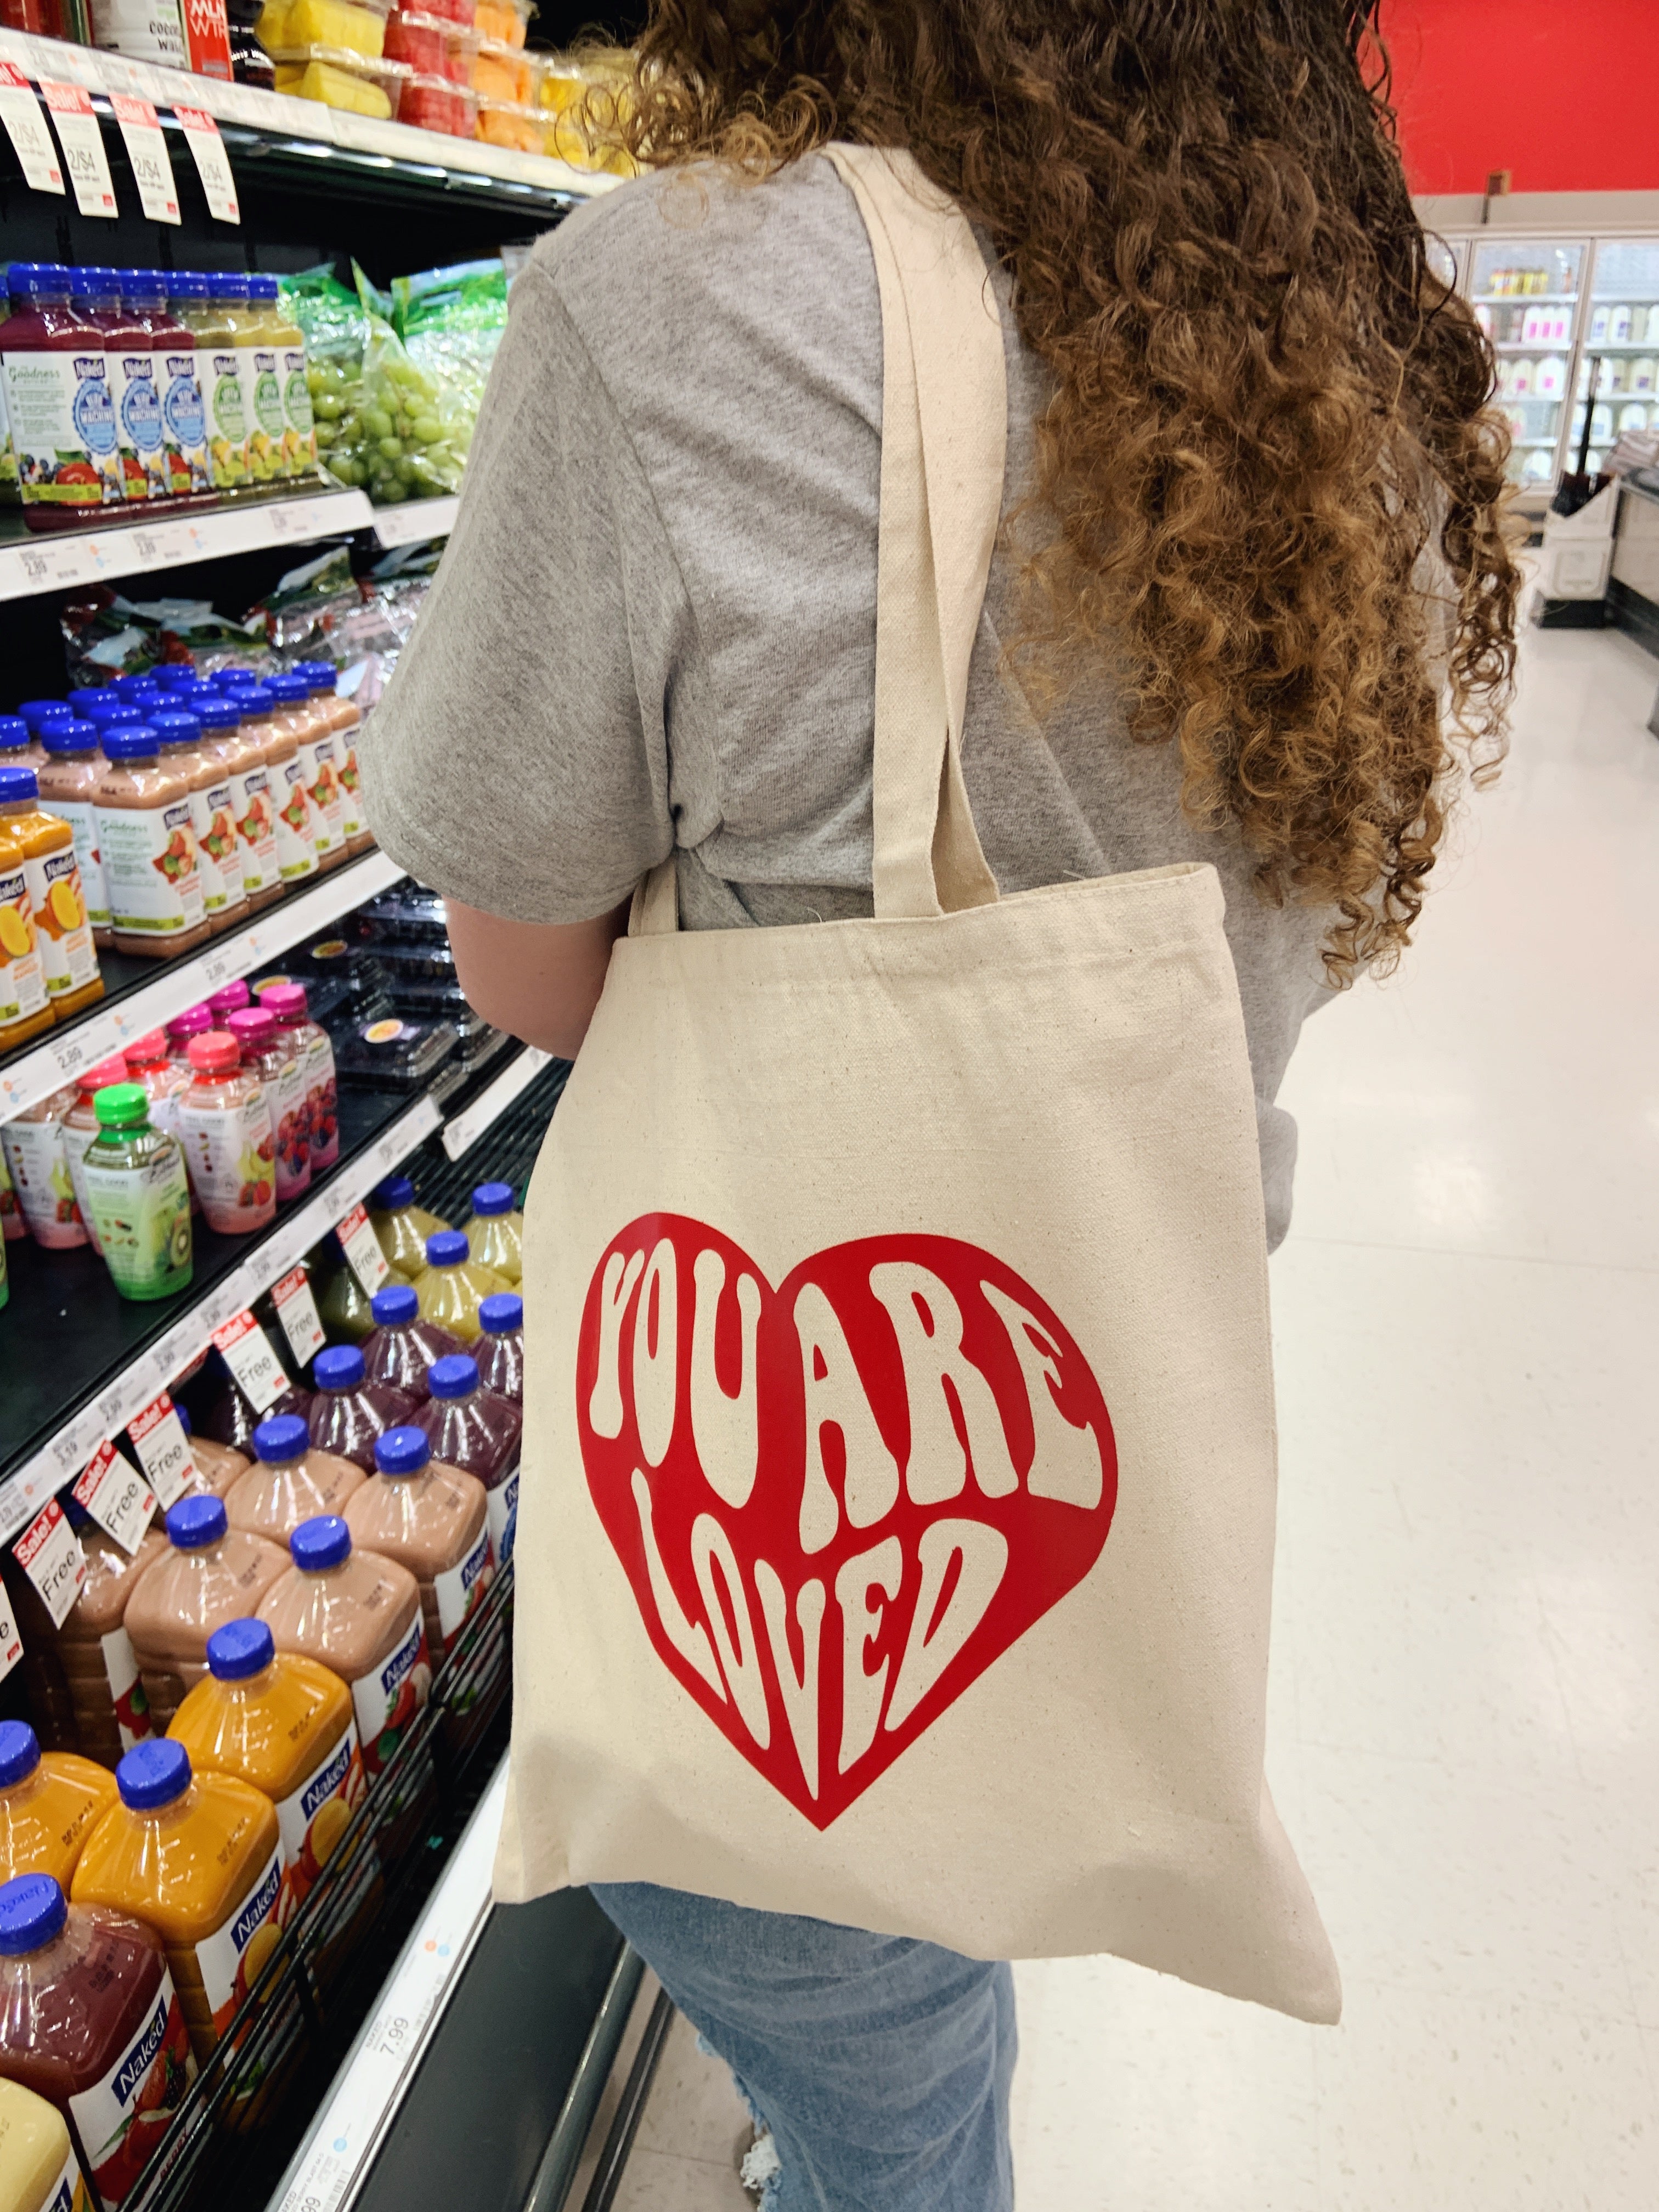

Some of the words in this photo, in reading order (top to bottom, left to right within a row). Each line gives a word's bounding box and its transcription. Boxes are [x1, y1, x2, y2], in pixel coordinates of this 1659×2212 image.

[0, 878, 24, 900] aked
[46, 854, 76, 879] Naked
[287, 1312, 313, 1342] Free
[237, 1357, 272, 1387] Free
[589, 1238, 761, 1509] YOU
[794, 1261, 1103, 1555] ARE
[76, 1454, 108, 1504] Sale!
[148, 1444, 182, 1482] Free
[106, 1481, 139, 1534] Free
[17, 1515, 52, 1564] Sale!
[42, 1550, 75, 1601] Free
[631, 1468, 1008, 1801] LOVED
[307, 1748, 349, 1812] Naked
[238, 1870, 279, 1943] Naked
[120, 2011, 165, 2095] Naked
[380, 2018, 409, 2055] 7.99
